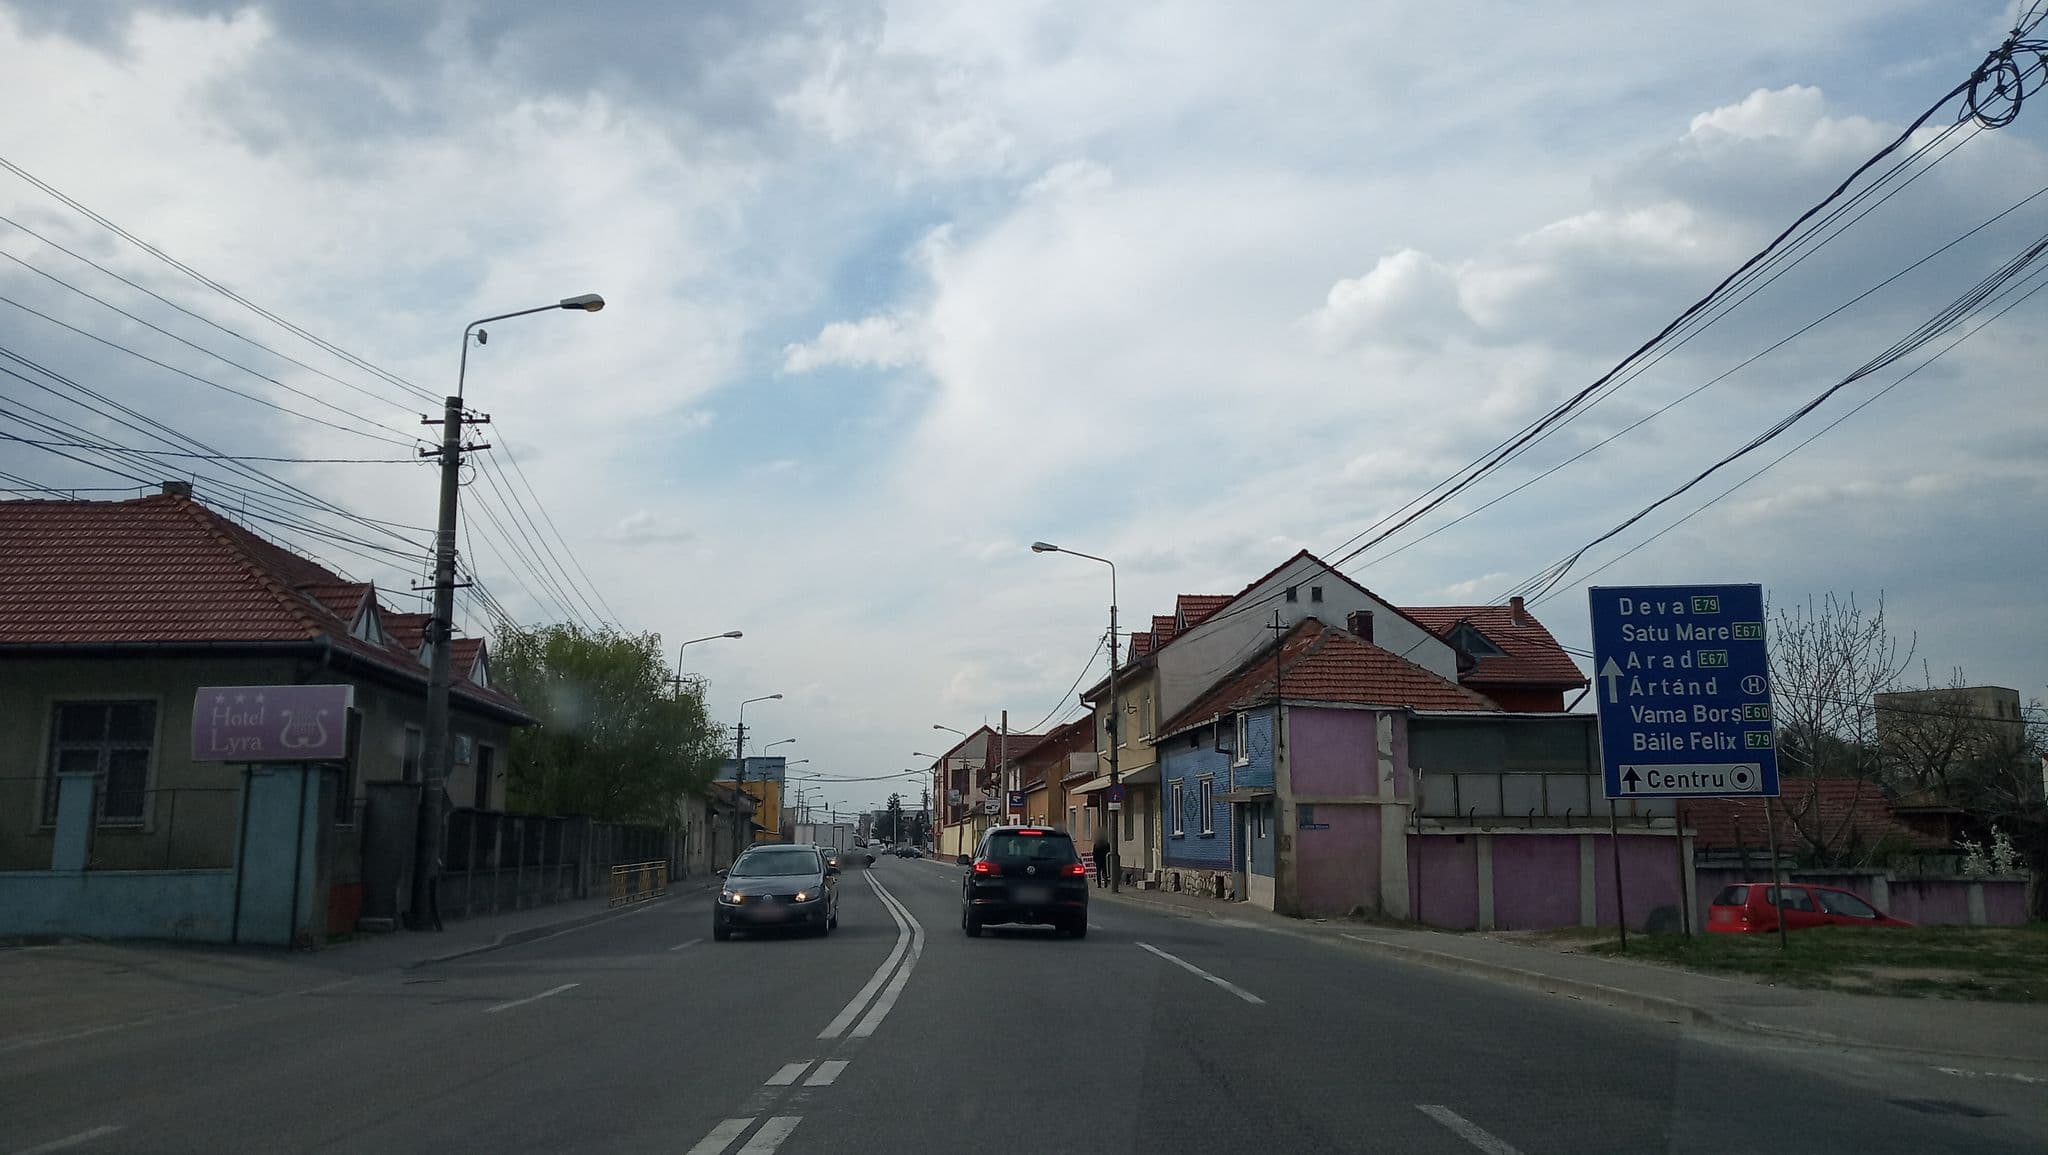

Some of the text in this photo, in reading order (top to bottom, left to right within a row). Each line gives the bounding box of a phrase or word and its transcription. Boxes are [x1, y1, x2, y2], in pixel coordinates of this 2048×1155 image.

[1619, 597, 1717, 615] Deva E79
[1622, 623, 1761, 642] Satu Mare E671
[1627, 650, 1726, 669] Arad E671
[1629, 675, 1718, 696] Ártánd
[1630, 704, 1687, 724] Vama
[1744, 706, 1768, 719] E60
[211, 728, 262, 754] Lyra
[1633, 731, 1770, 751] Băile Felix E79
[1647, 769, 1724, 789] Centru
